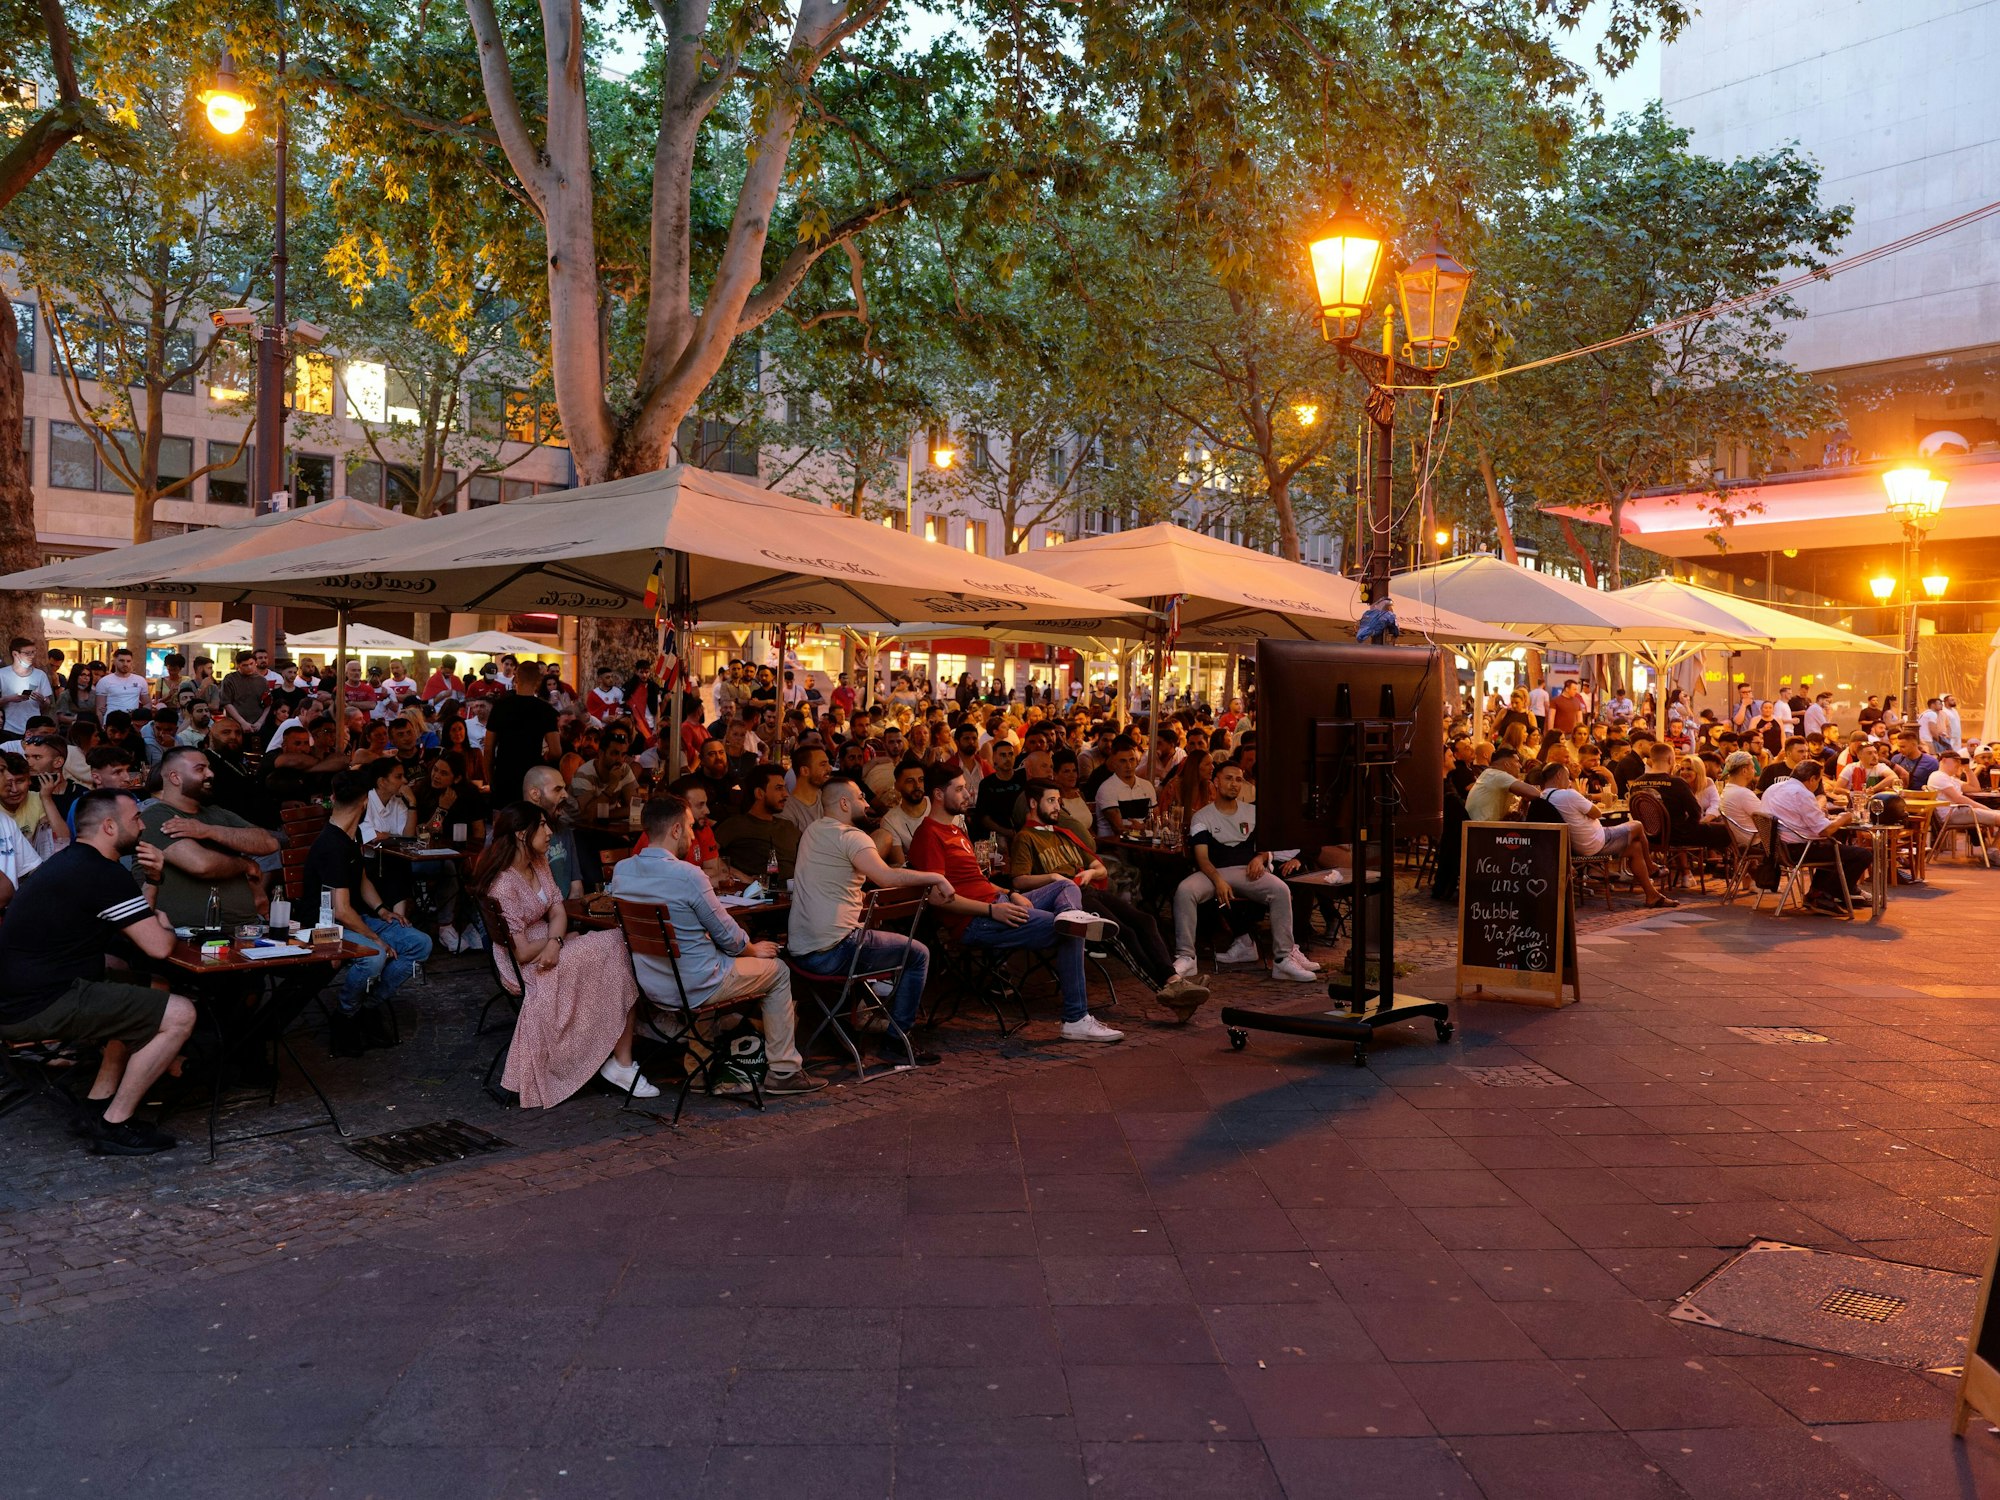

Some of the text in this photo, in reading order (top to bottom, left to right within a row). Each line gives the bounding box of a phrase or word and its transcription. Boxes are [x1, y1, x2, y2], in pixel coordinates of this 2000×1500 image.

[1495, 836, 1531, 846] MARTINI
[1475, 856, 1533, 876] Neu bei
[1491, 879, 1520, 893] uns
[1470, 902, 1519, 920] Bubble
[1483, 924, 1541, 946] Waffeln
